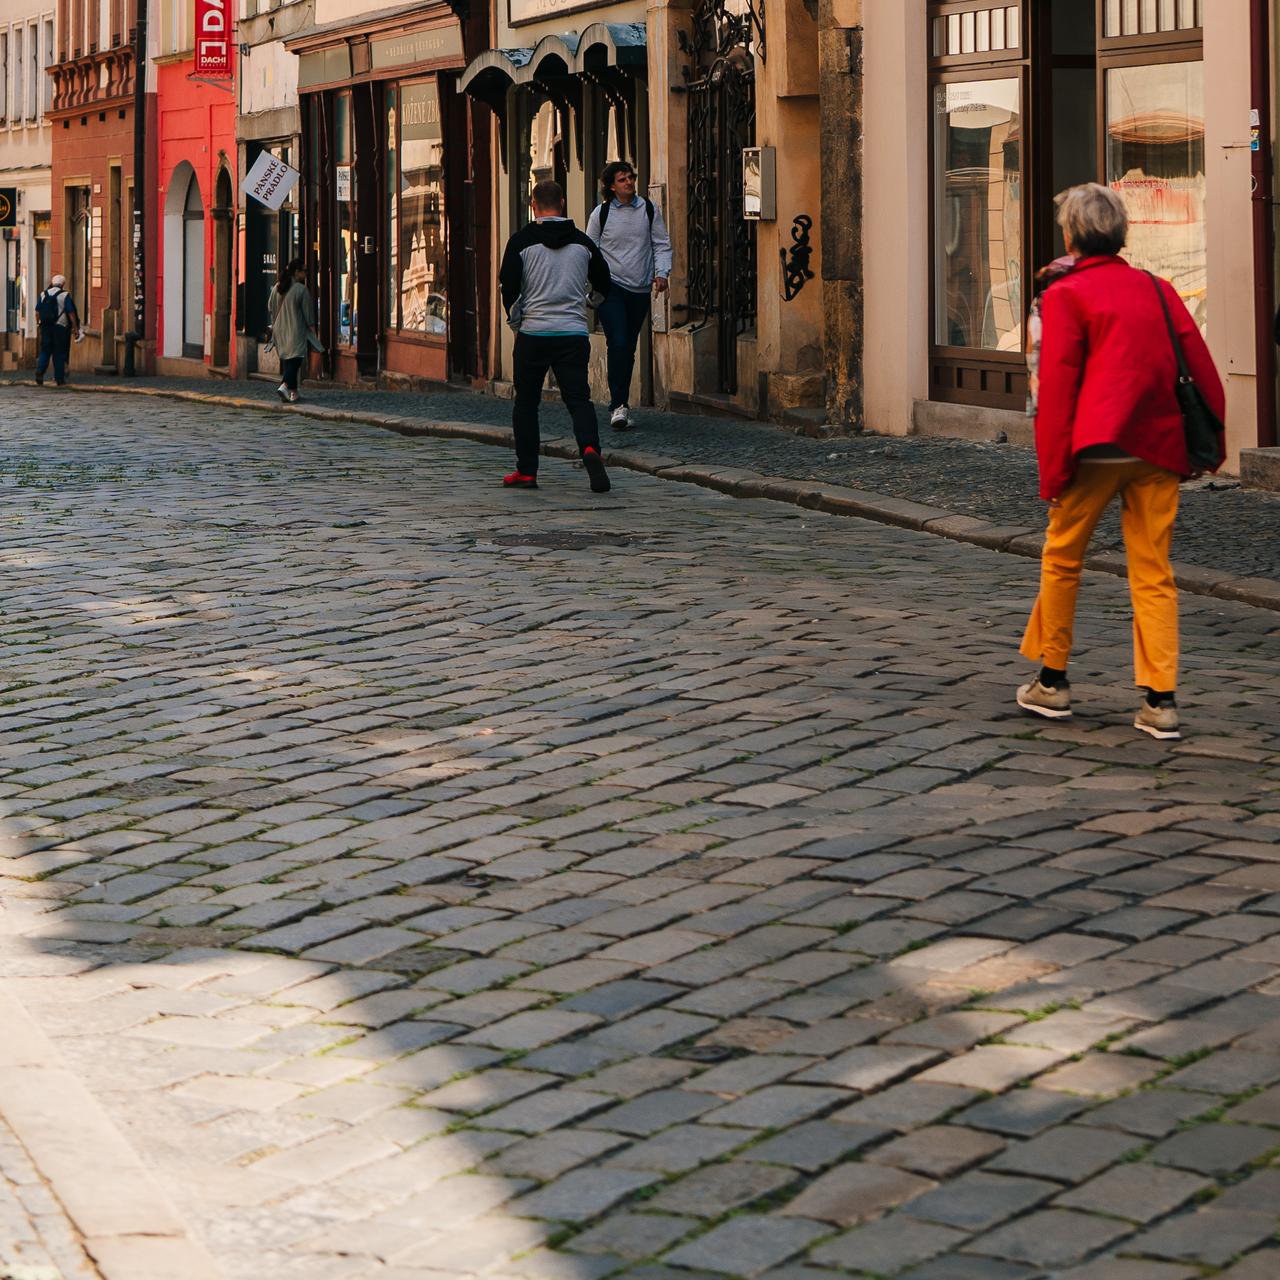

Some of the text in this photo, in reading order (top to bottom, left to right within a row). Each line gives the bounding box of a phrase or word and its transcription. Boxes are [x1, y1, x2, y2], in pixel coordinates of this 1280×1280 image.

[201, 56, 226, 64] DACHI
[253, 160, 279, 196] PÁNSKÉ
[262, 165, 288, 201] PRÁDLO
